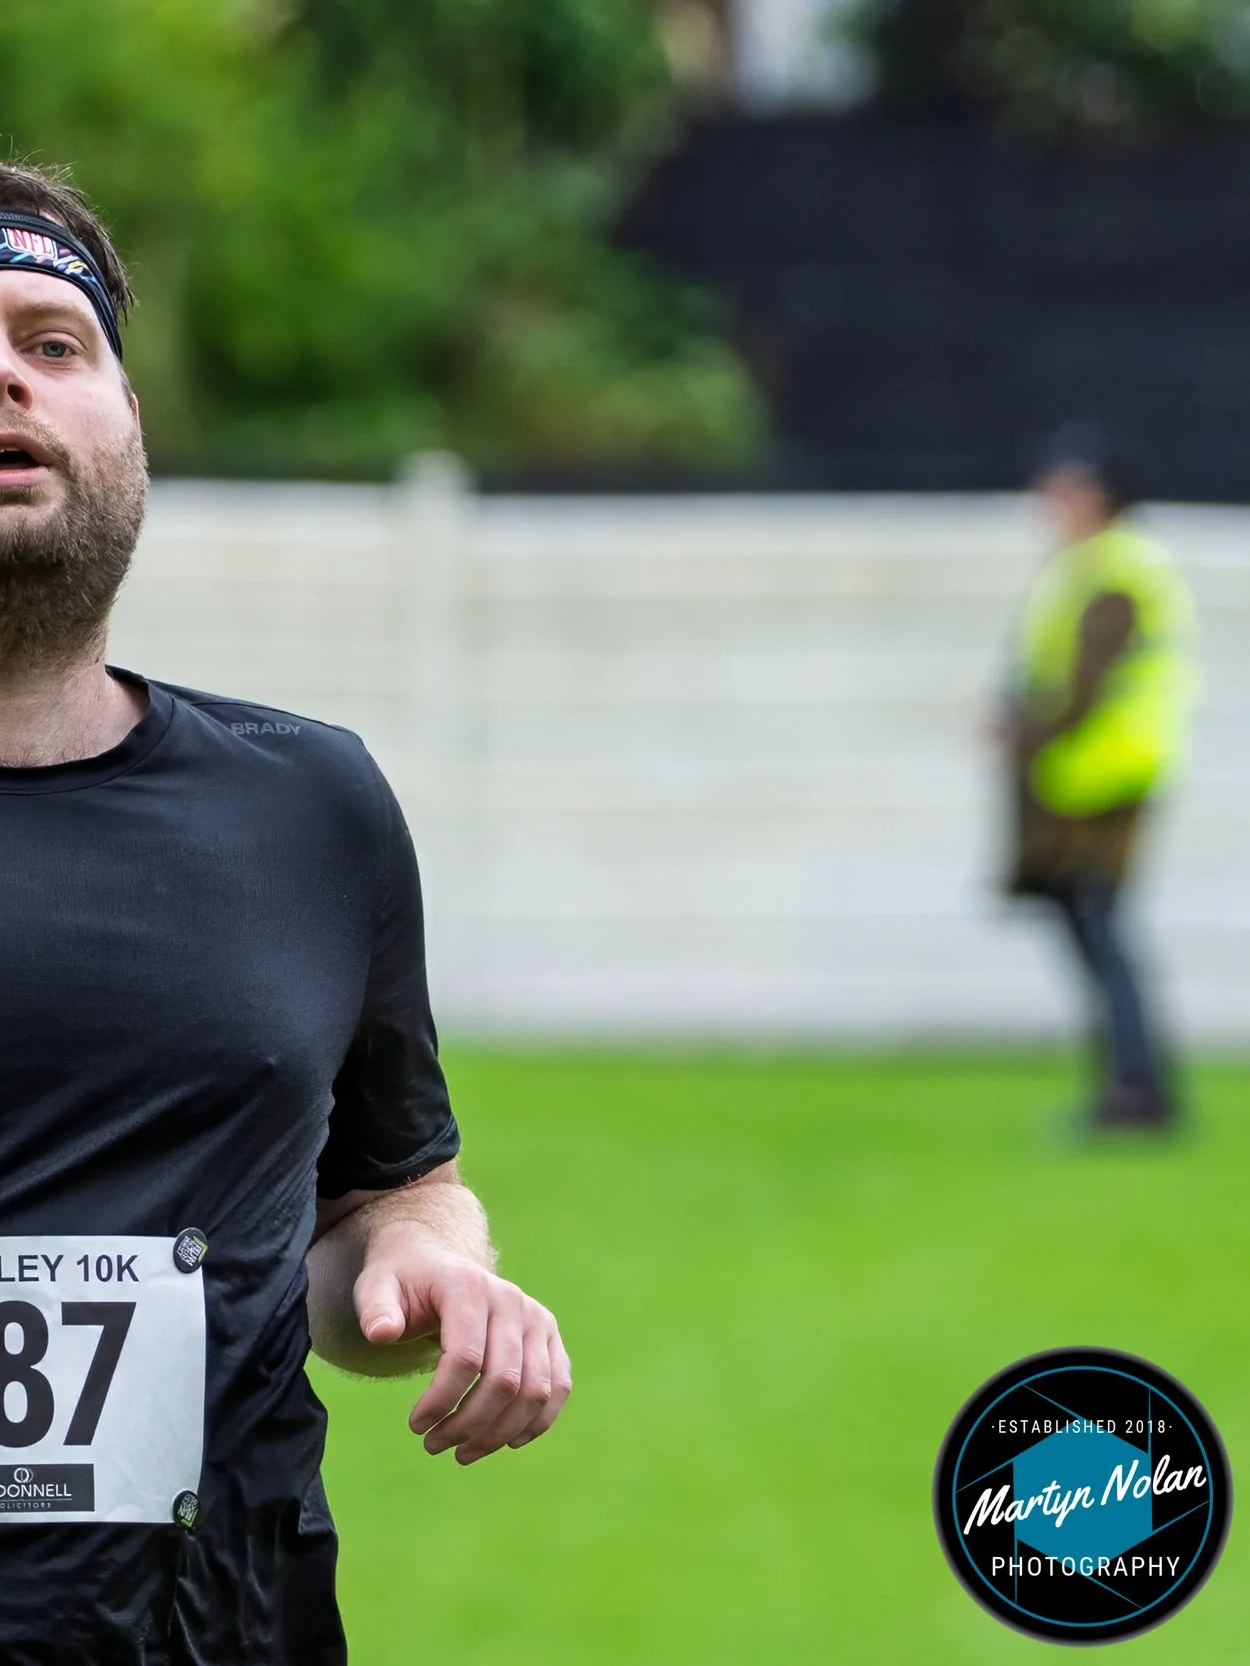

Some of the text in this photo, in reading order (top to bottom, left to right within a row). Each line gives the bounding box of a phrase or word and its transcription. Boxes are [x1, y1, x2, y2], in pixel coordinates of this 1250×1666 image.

[11, 227, 52, 255] NFL
[230, 721, 301, 736] BRADY
[76, 1254, 140, 1283] 10K
